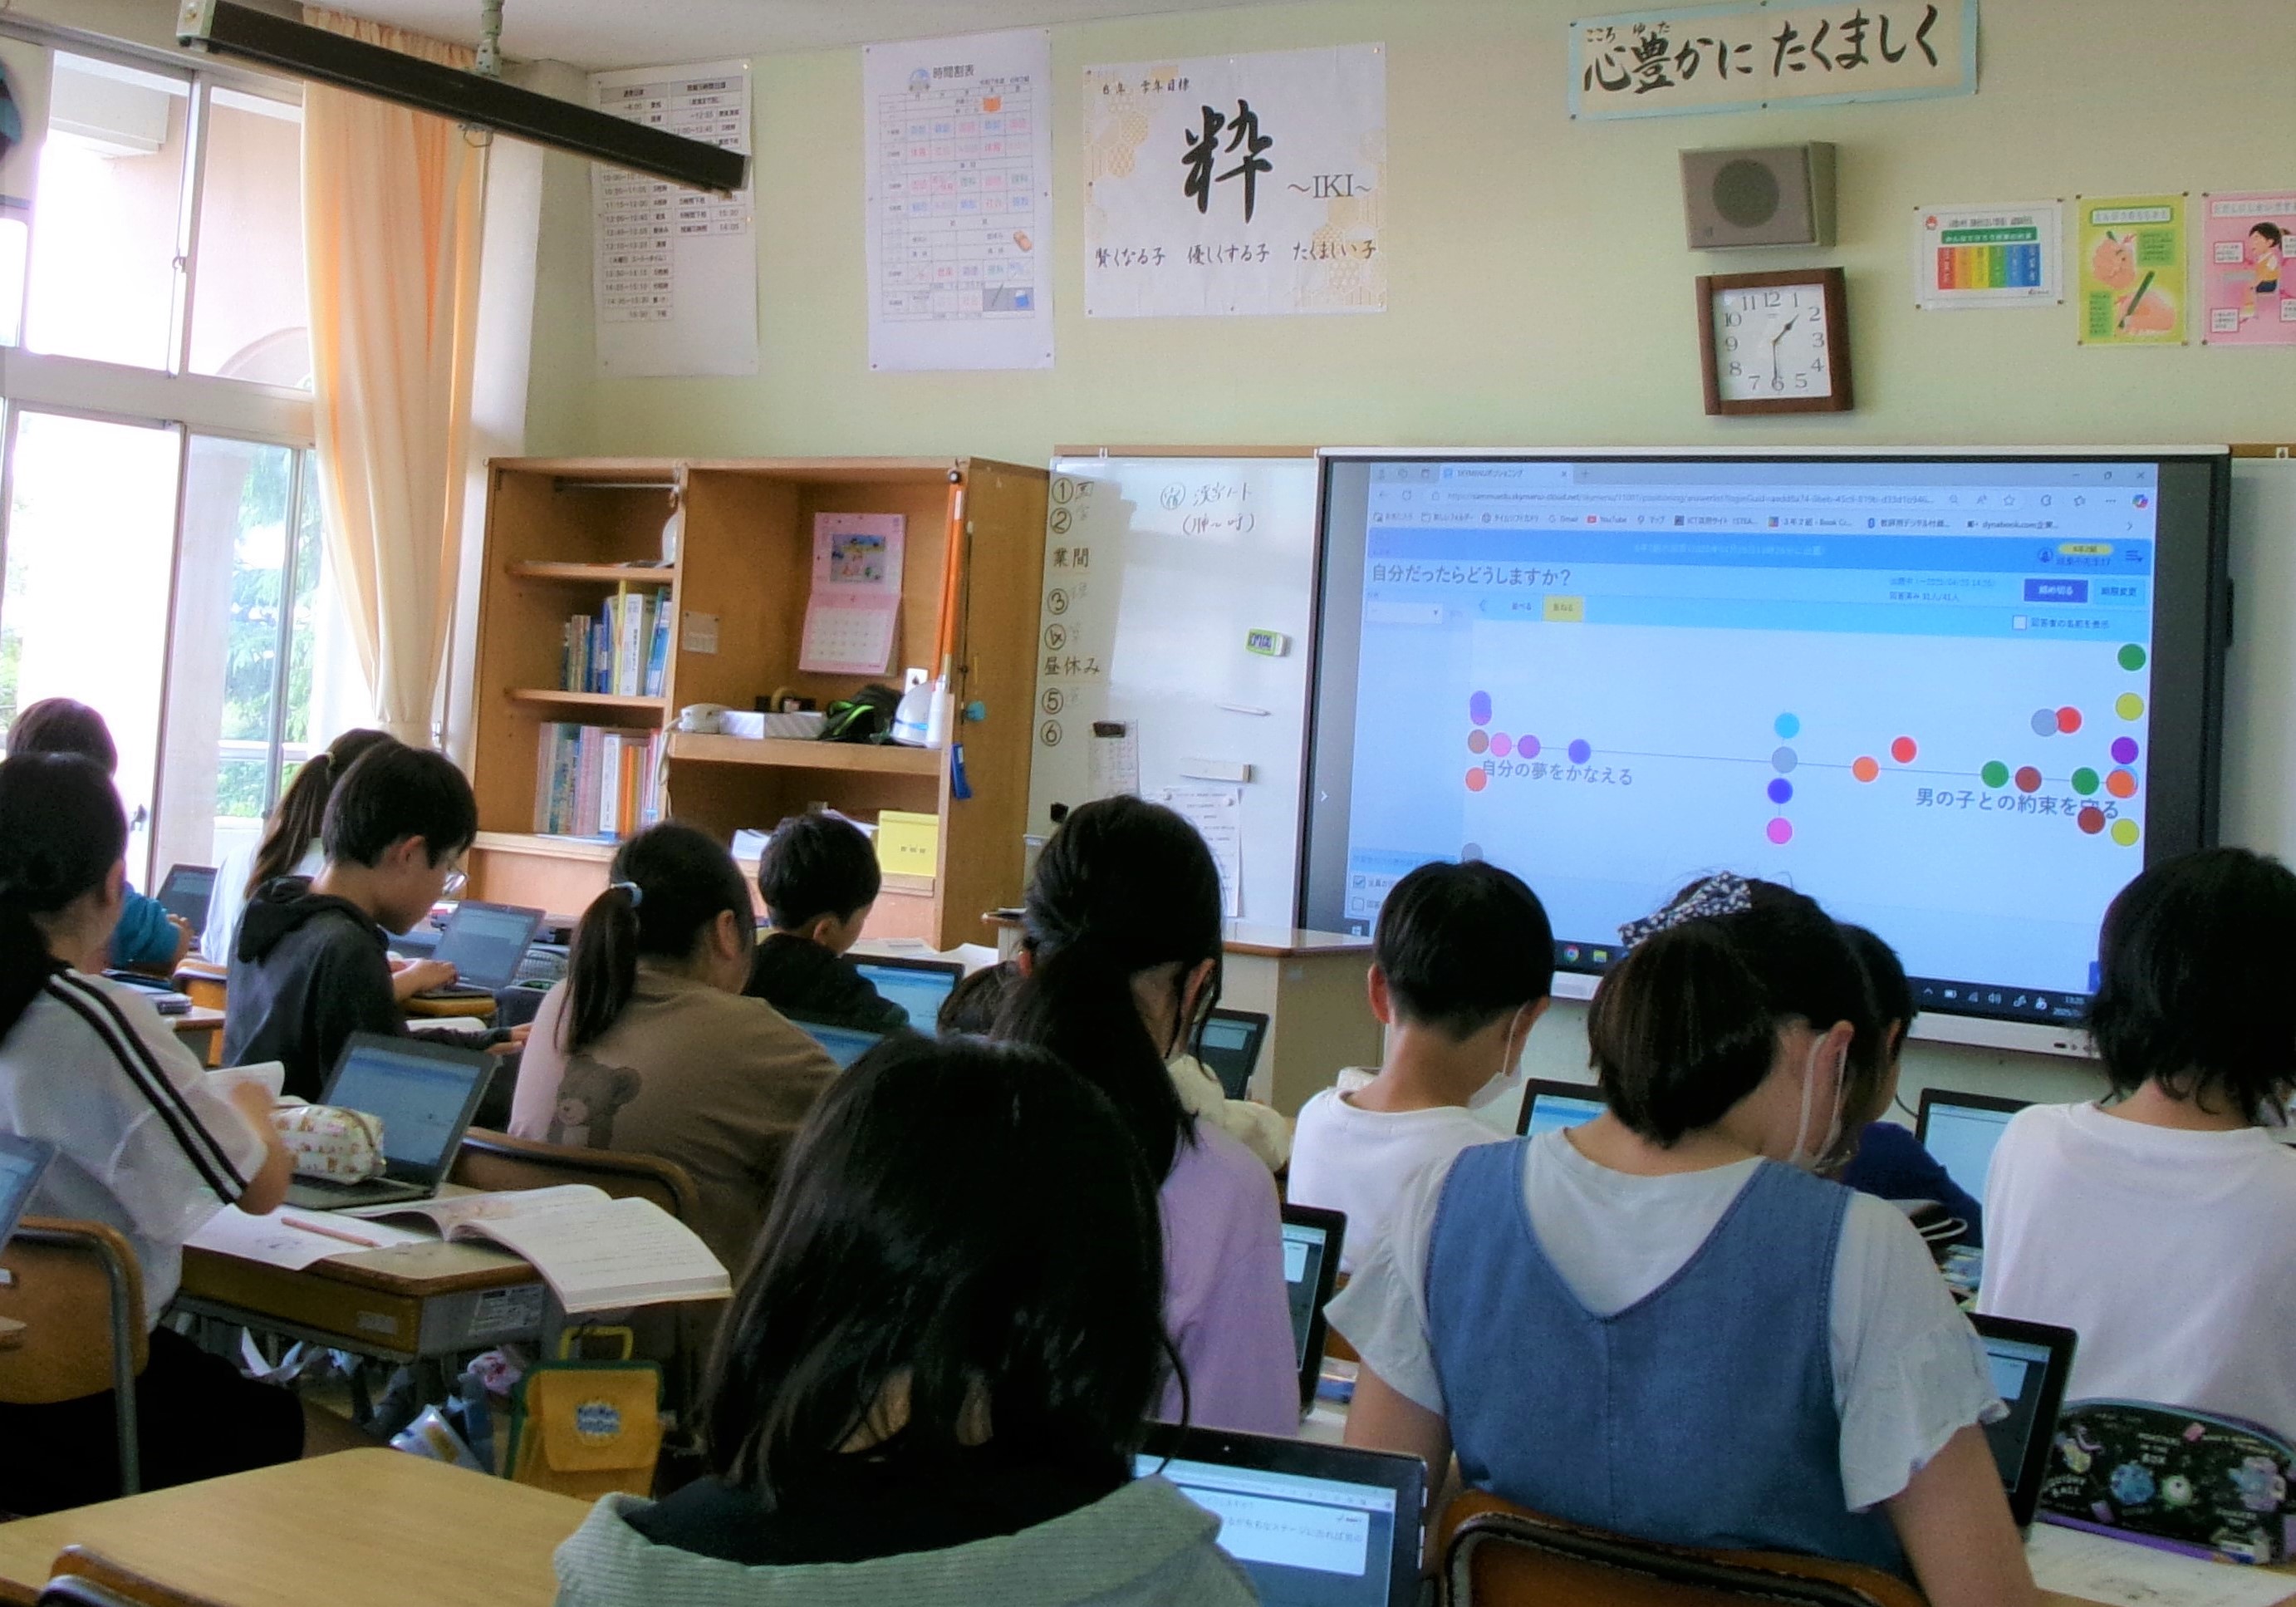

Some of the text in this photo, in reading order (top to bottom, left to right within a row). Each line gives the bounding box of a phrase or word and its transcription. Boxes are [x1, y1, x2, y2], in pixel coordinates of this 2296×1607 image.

[1587, 27, 1616, 42] こころ
[1583, 3, 1938, 94] 心豊かに たくましく
[933, 64, 974, 79] 時間割表
[1181, 99, 1273, 224] 粋
[1095, 239, 1376, 268] 賢くなる子 優しくする子 たくましい子
[1743, 295, 1756, 311] 11
[1764, 292, 1781, 307] 12
[1793, 292, 1798, 307] 1
[1724, 312, 1742, 327] 10
[1808, 306, 1821, 322] 2
[1725, 337, 1738, 351] 9
[1812, 332, 1825, 348] 3
[1729, 361, 1742, 376] 8
[1810, 357, 1824, 373] 4
[1748, 376, 1761, 391] 7
[1771, 376, 1784, 391] 6
[1794, 373, 1808, 388] 5
[1052, 548, 1089, 568] 業間
[1373, 563, 1571, 586] 自分だったらどうしますか？
[1045, 656, 1101, 676] 昼休み
[1484, 759, 1633, 787] 自分の夢をかなえる
